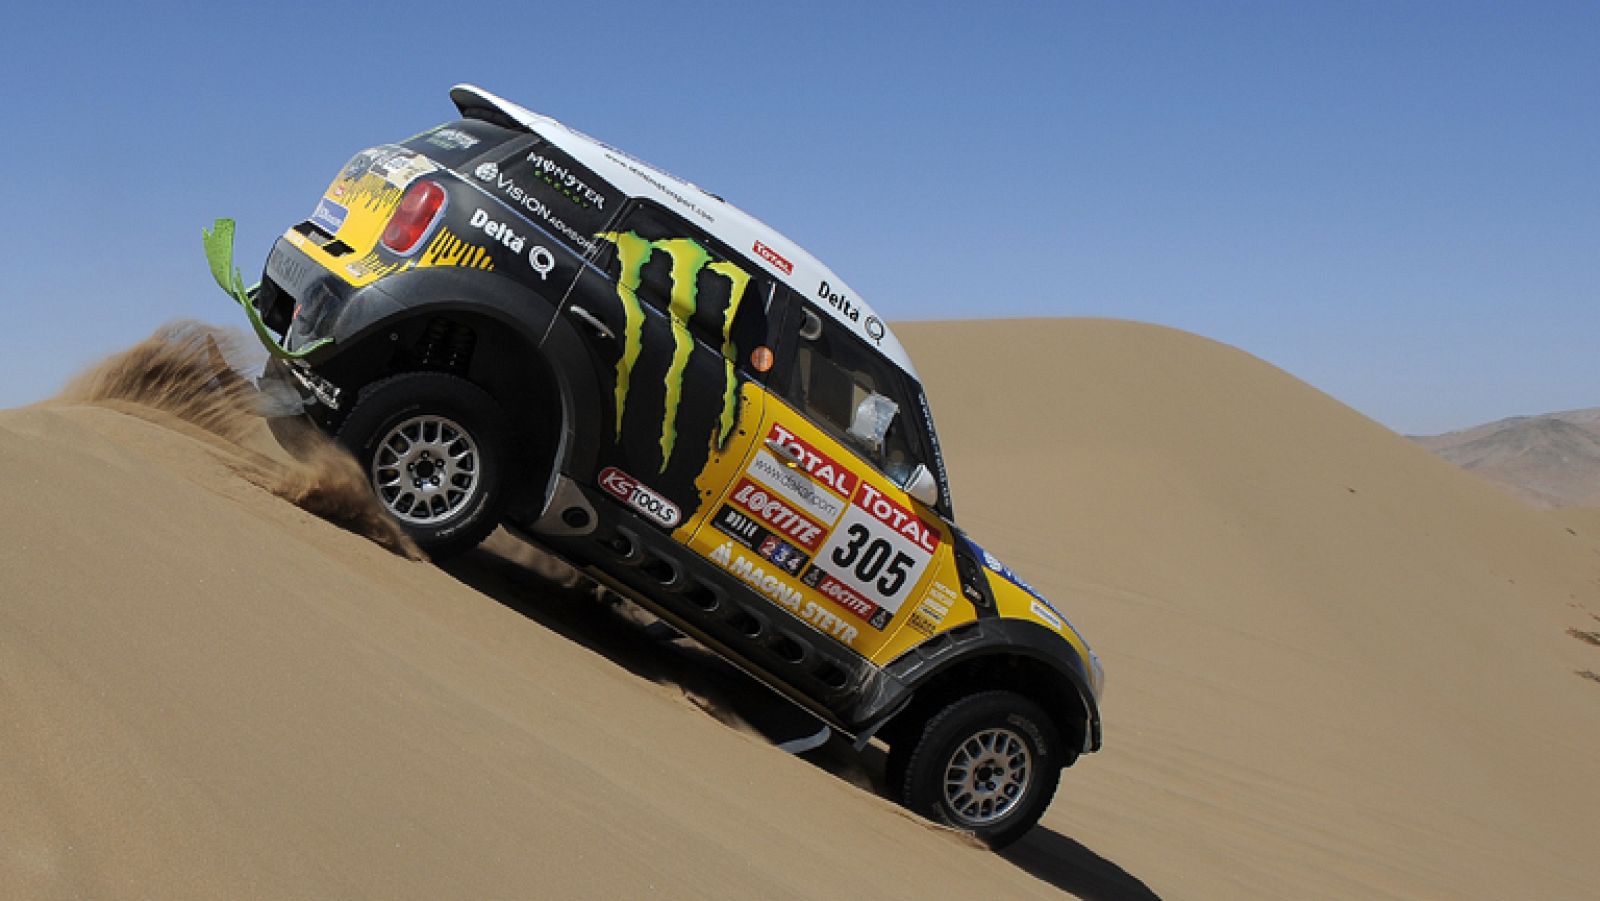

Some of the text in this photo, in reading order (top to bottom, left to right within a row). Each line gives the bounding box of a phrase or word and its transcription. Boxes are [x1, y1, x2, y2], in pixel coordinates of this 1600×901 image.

[526, 151, 605, 210] MONSTER
[754, 459, 837, 517] www.dakar.com
[774, 424, 850, 497] TOTAL
[632, 486, 674, 522] TOOLS
[734, 485, 822, 544] LOCTITE
[862, 483, 935, 550] TOTAL
[831, 523, 916, 597] 305
[730, 556, 803, 612] MAGNA
[802, 602, 859, 643] STEYR
